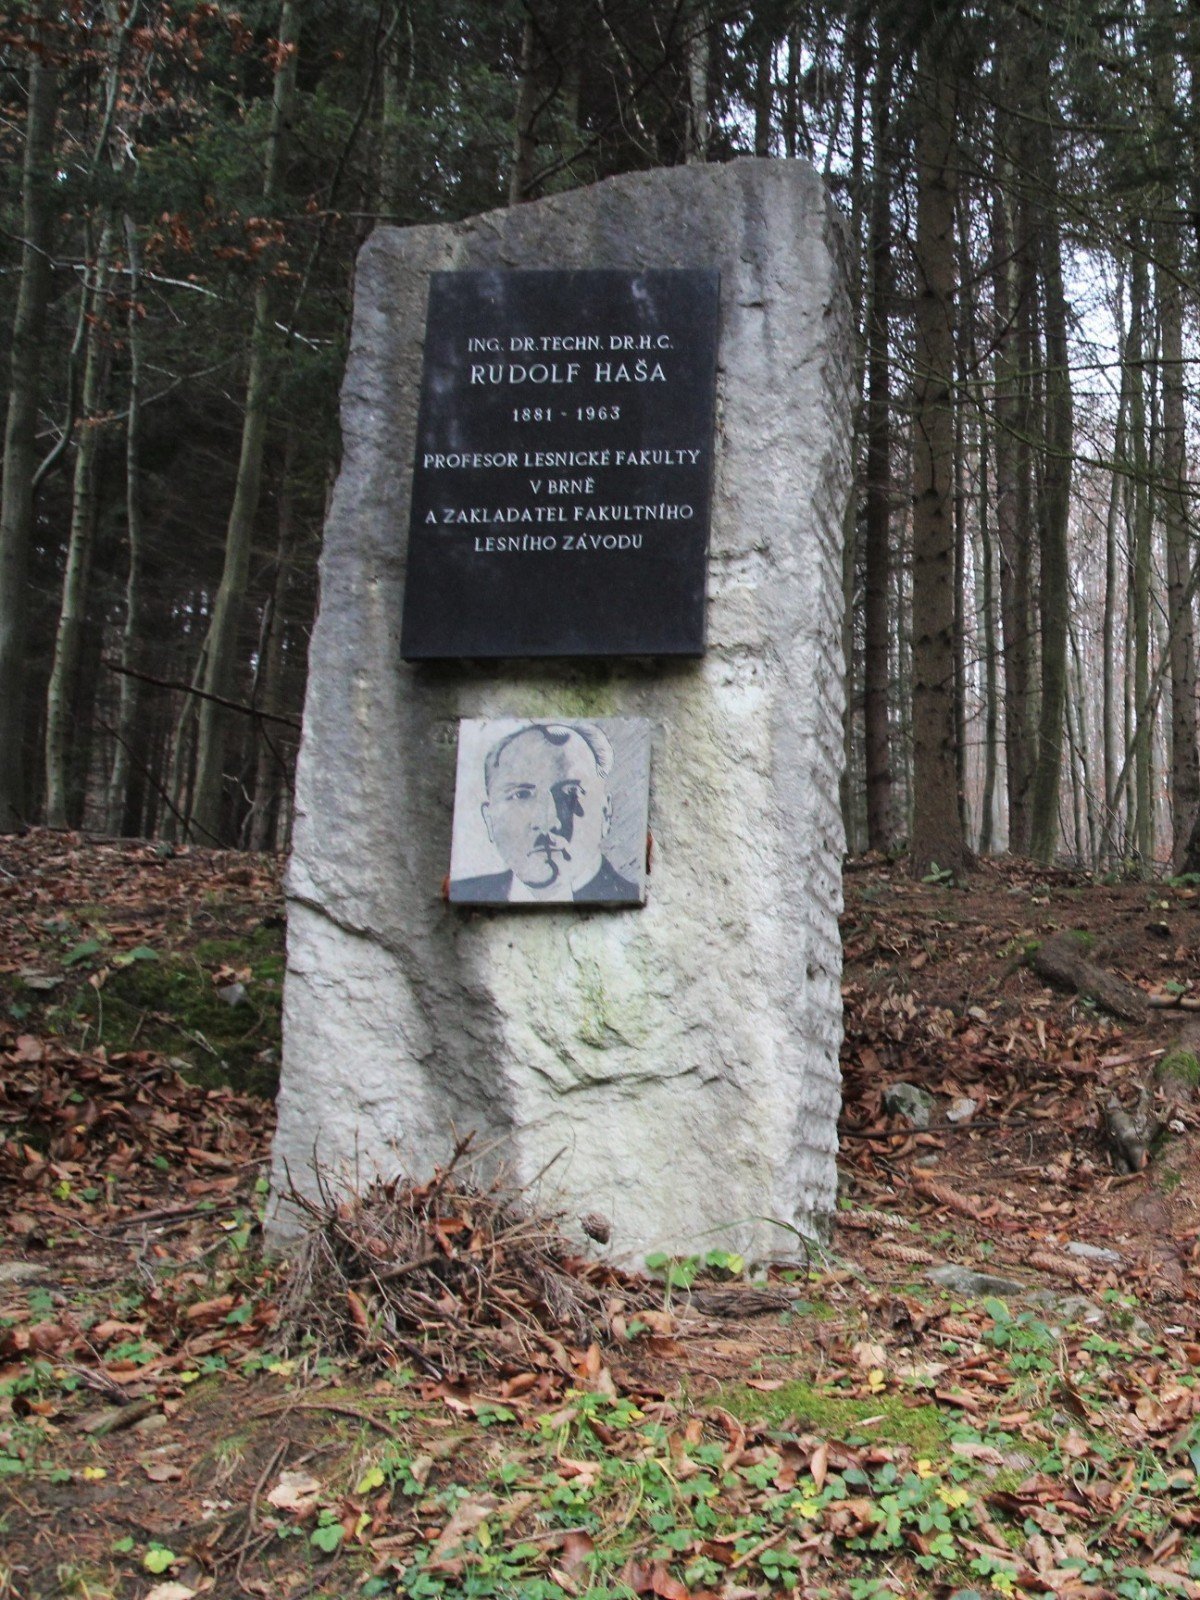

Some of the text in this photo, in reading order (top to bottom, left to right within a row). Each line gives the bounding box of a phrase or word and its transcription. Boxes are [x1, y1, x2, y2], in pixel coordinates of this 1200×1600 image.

[468, 338, 503, 352] ING.
[471, 358, 667, 385] RUDOLF HAŠA
[513, 407, 552, 422] 1881
[577, 406, 621, 420] 1963
[423, 449, 700, 469] PROFESOR LESNICKÉ FAKULTY
[530, 476, 595, 494] V BRNĚ
[425, 503, 694, 524] A ZAKLADATEL FAKULTNÍHO
[475, 533, 643, 552] LESNÍHO ZÁVODU
